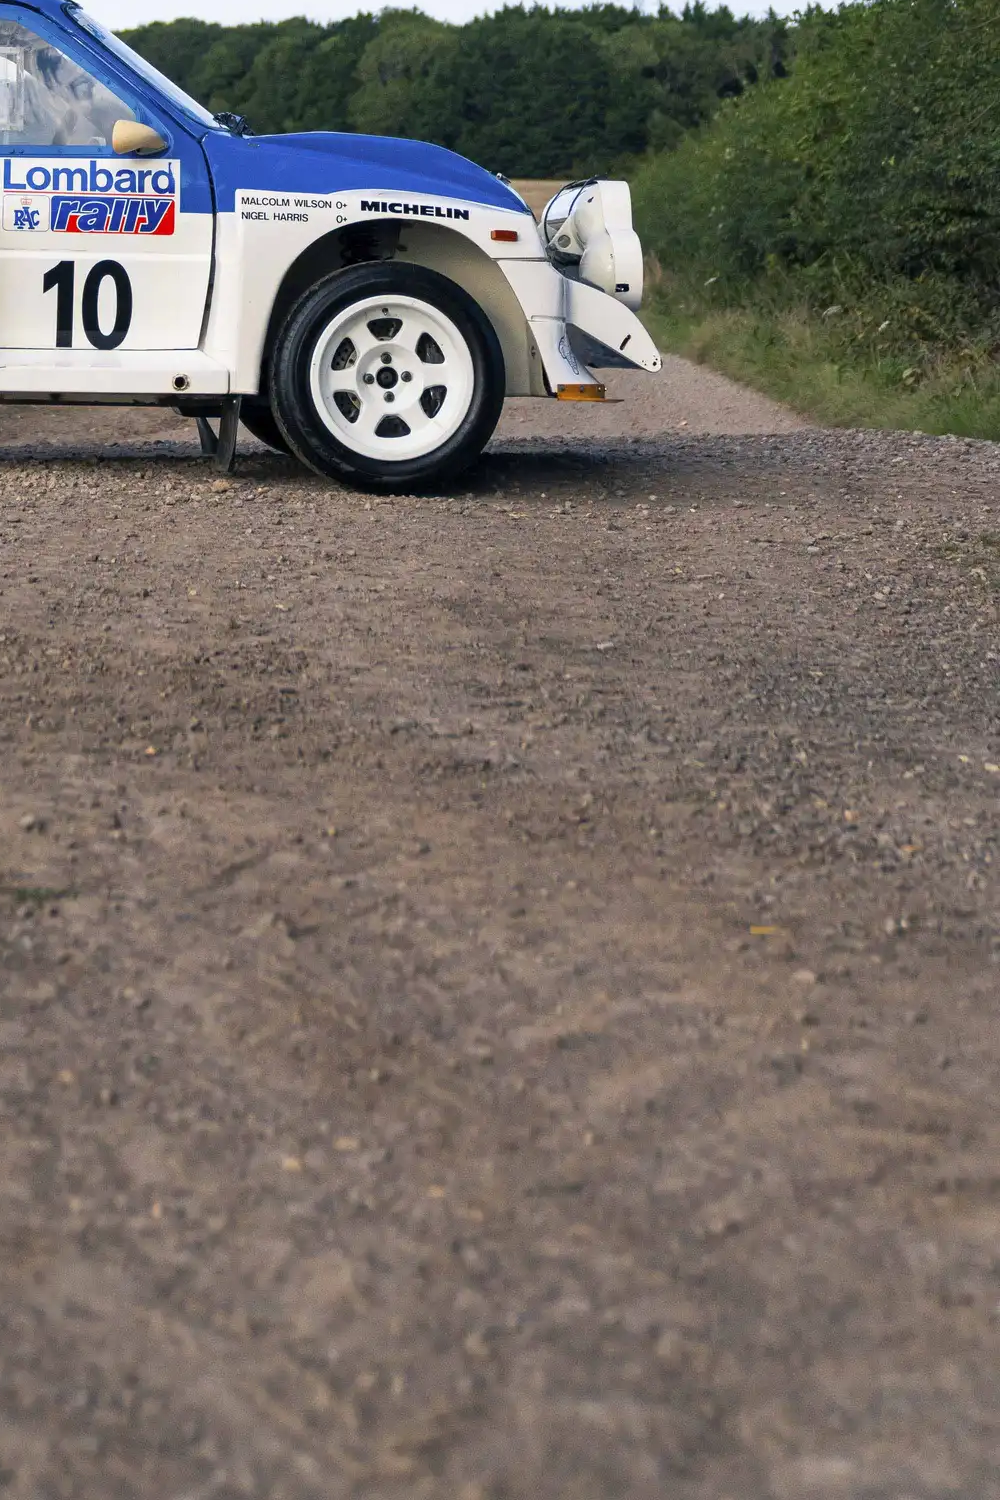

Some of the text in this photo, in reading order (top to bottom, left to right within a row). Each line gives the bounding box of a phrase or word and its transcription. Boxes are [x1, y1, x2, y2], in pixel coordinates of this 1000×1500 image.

[3, 159, 176, 194] Lombard
[13, 198, 173, 233] RAC rally
[241, 197, 290, 206] MALCOLM
[294, 199, 332, 209] WILSON
[241, 211, 269, 220] NIGEL
[273, 213, 309, 222] HARRIS
[360, 200, 470, 220] MICHELIN
[43, 259, 133, 350] 10
